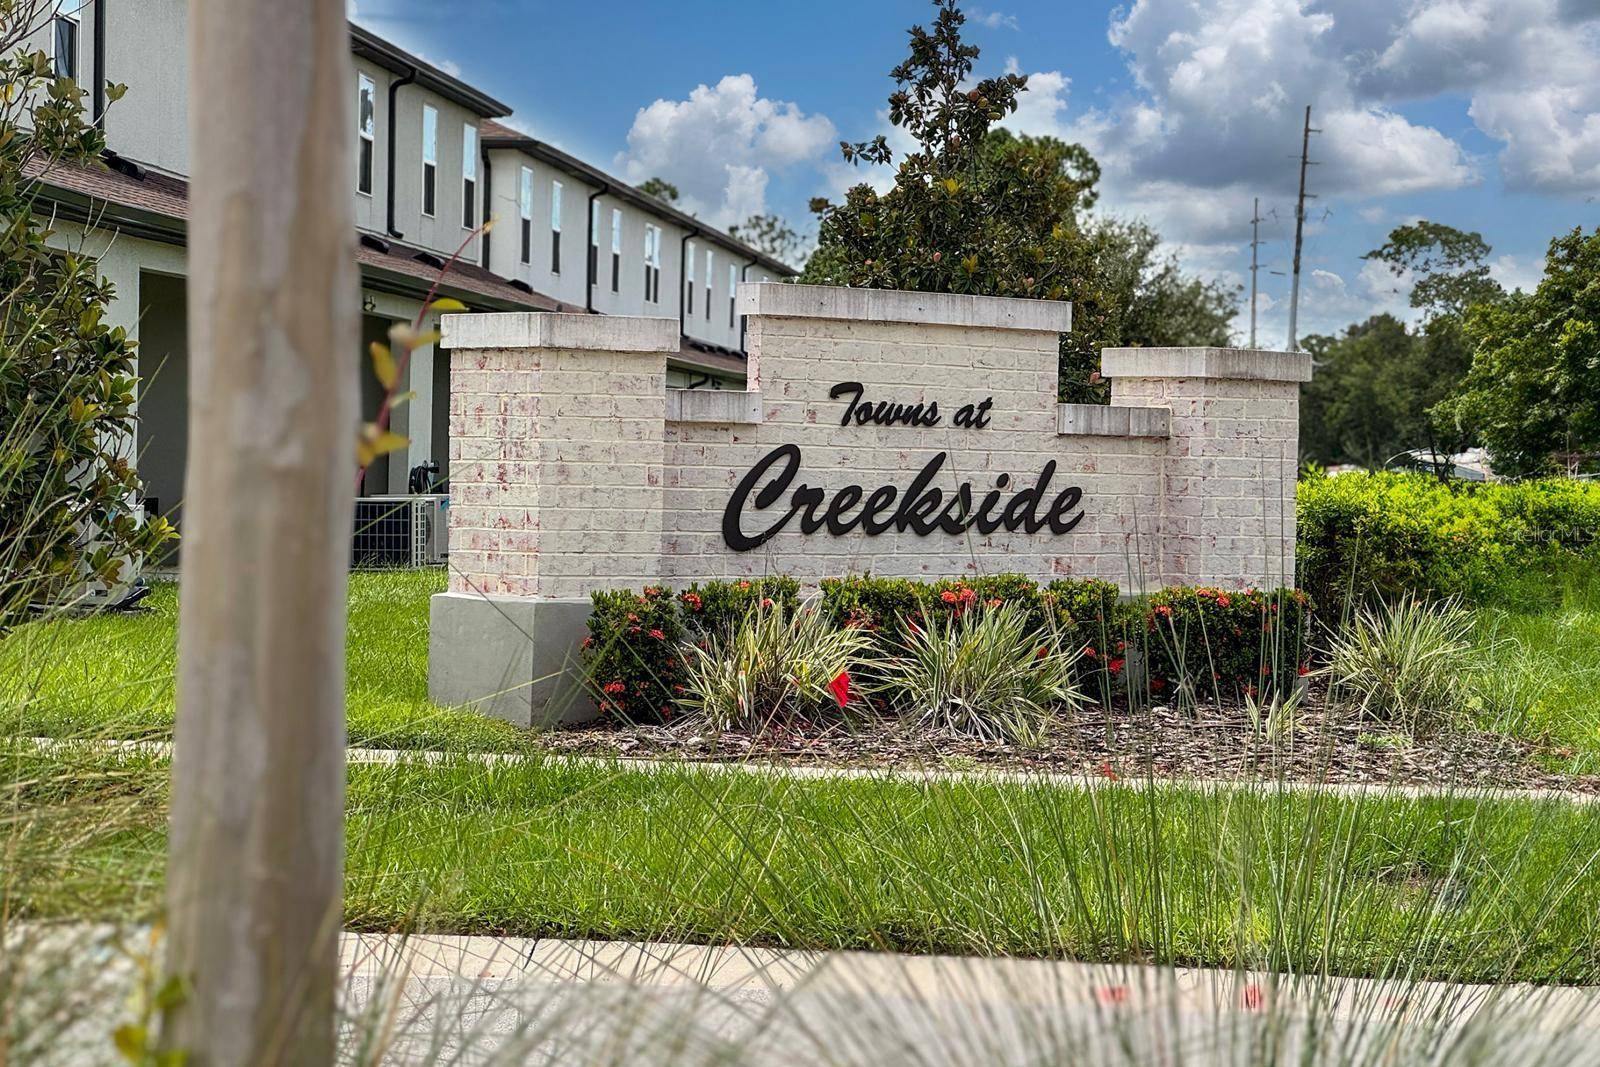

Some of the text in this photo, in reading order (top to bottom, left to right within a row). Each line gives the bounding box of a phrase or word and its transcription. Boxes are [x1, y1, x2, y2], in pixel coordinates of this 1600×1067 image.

[829, 381, 993, 429] Towns at
[722, 444, 1084, 552] Creekside
